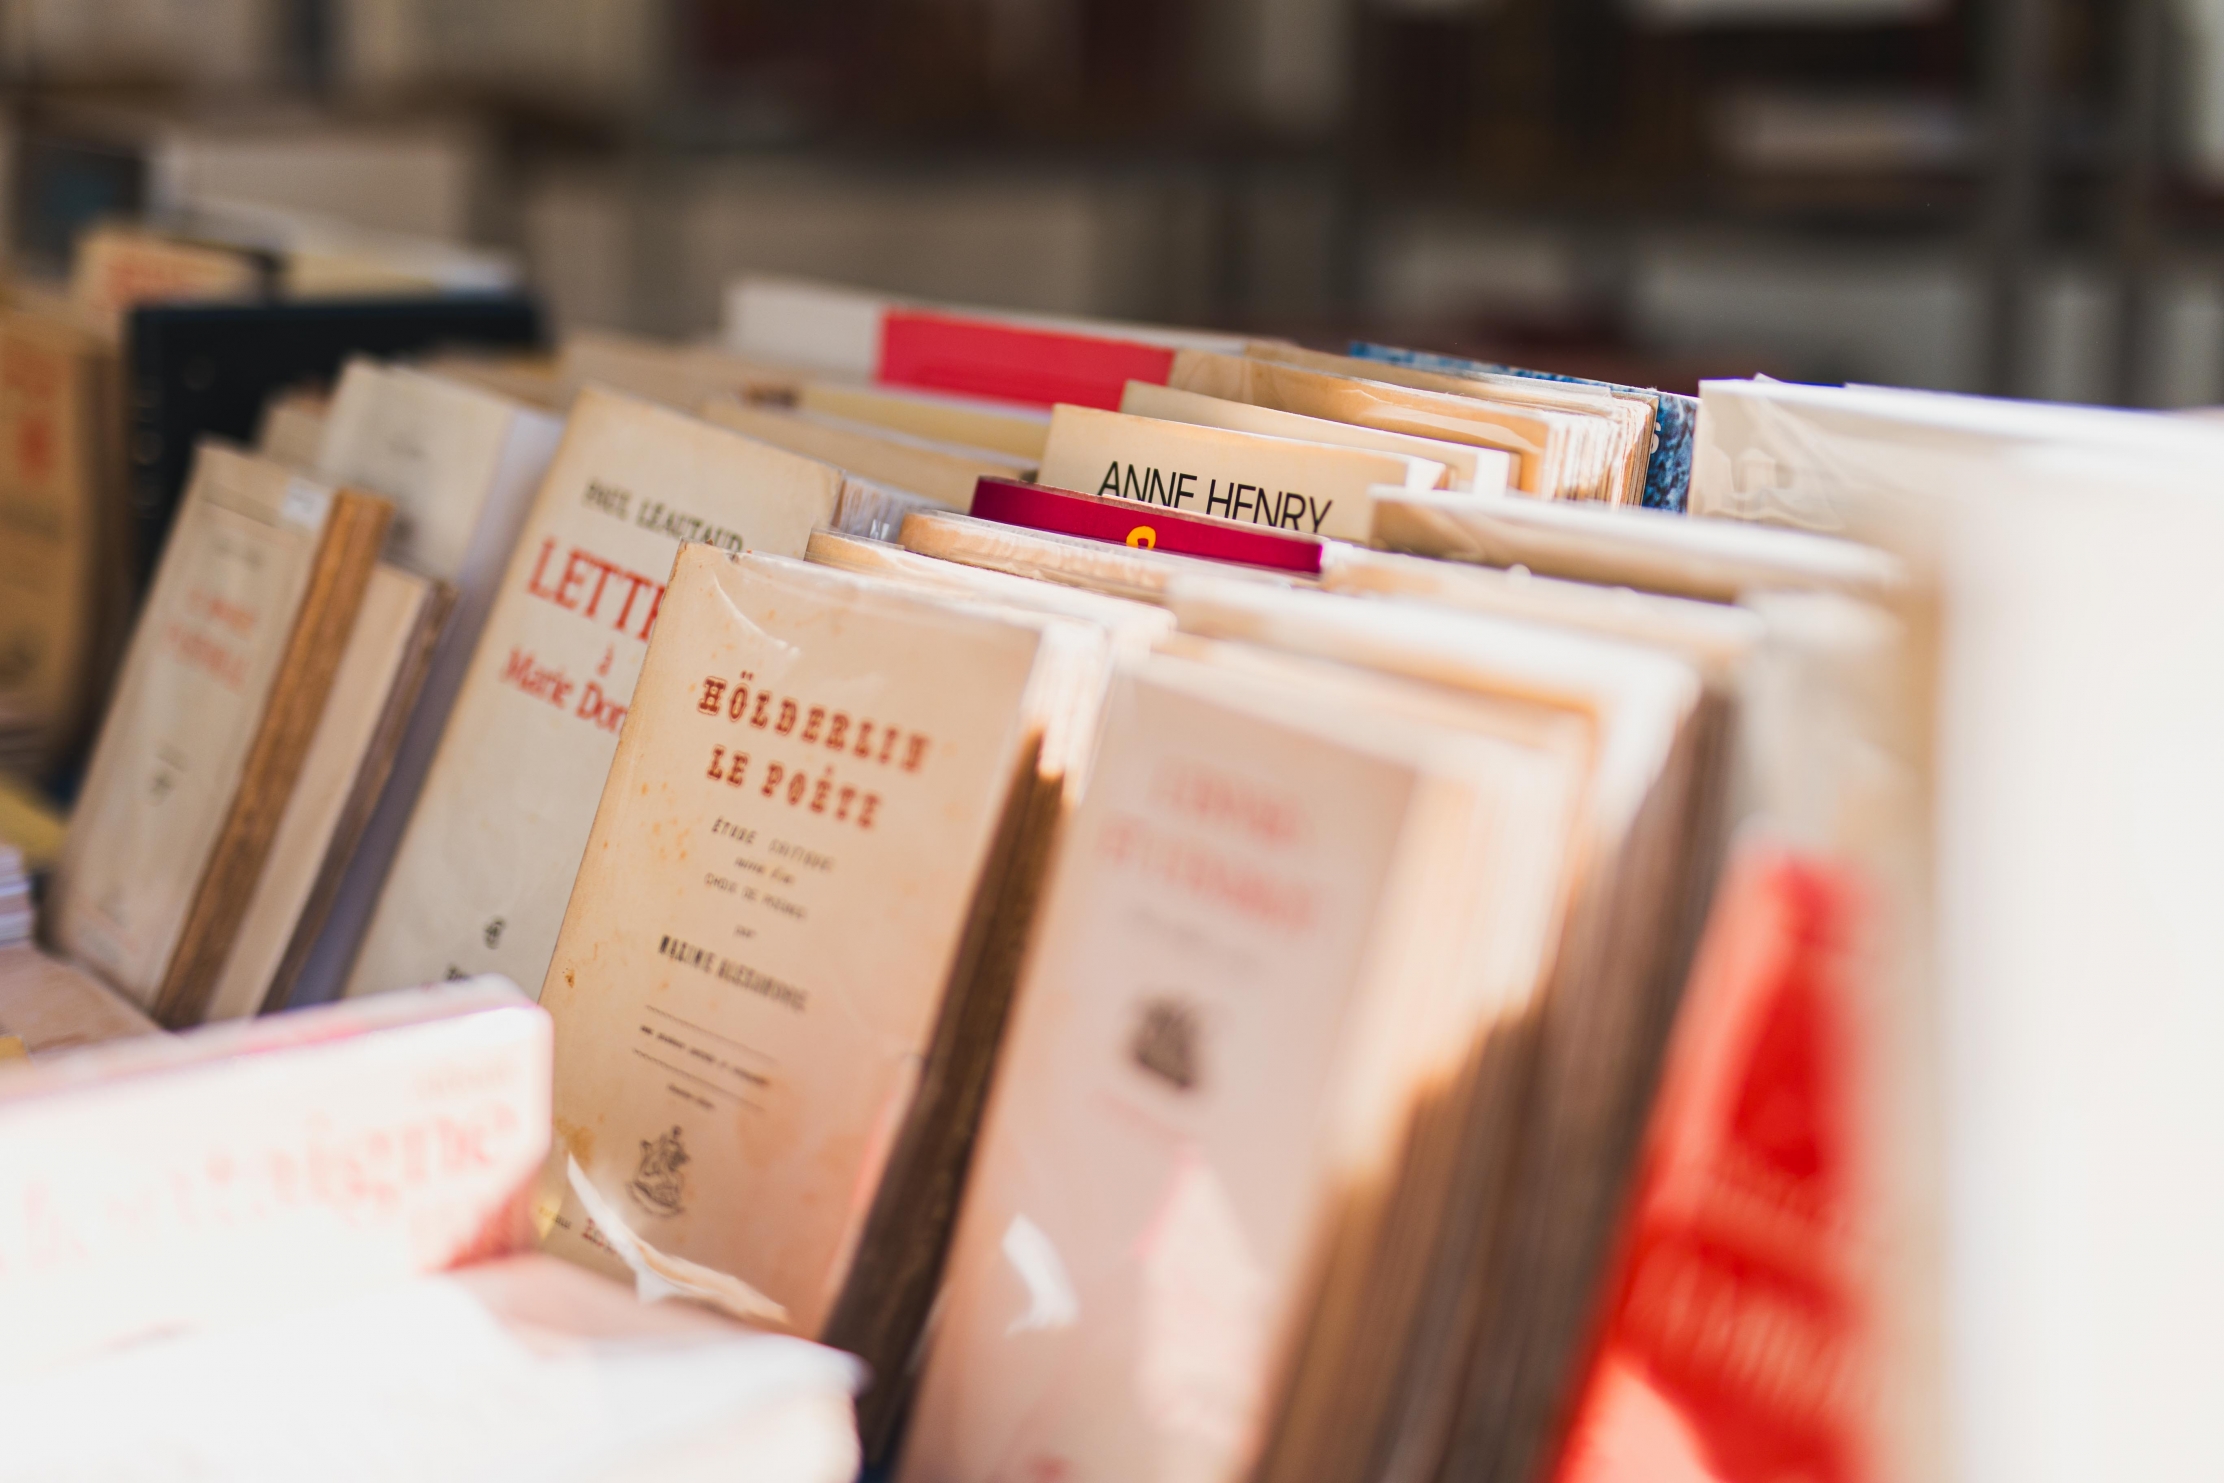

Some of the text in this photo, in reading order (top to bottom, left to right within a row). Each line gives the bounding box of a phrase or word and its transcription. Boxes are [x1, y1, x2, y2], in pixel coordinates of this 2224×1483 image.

[1097, 461, 1333, 533] ANNE HENRY
[697, 671, 932, 775] HÖLDERLIN
[706, 744, 751, 788] LE
